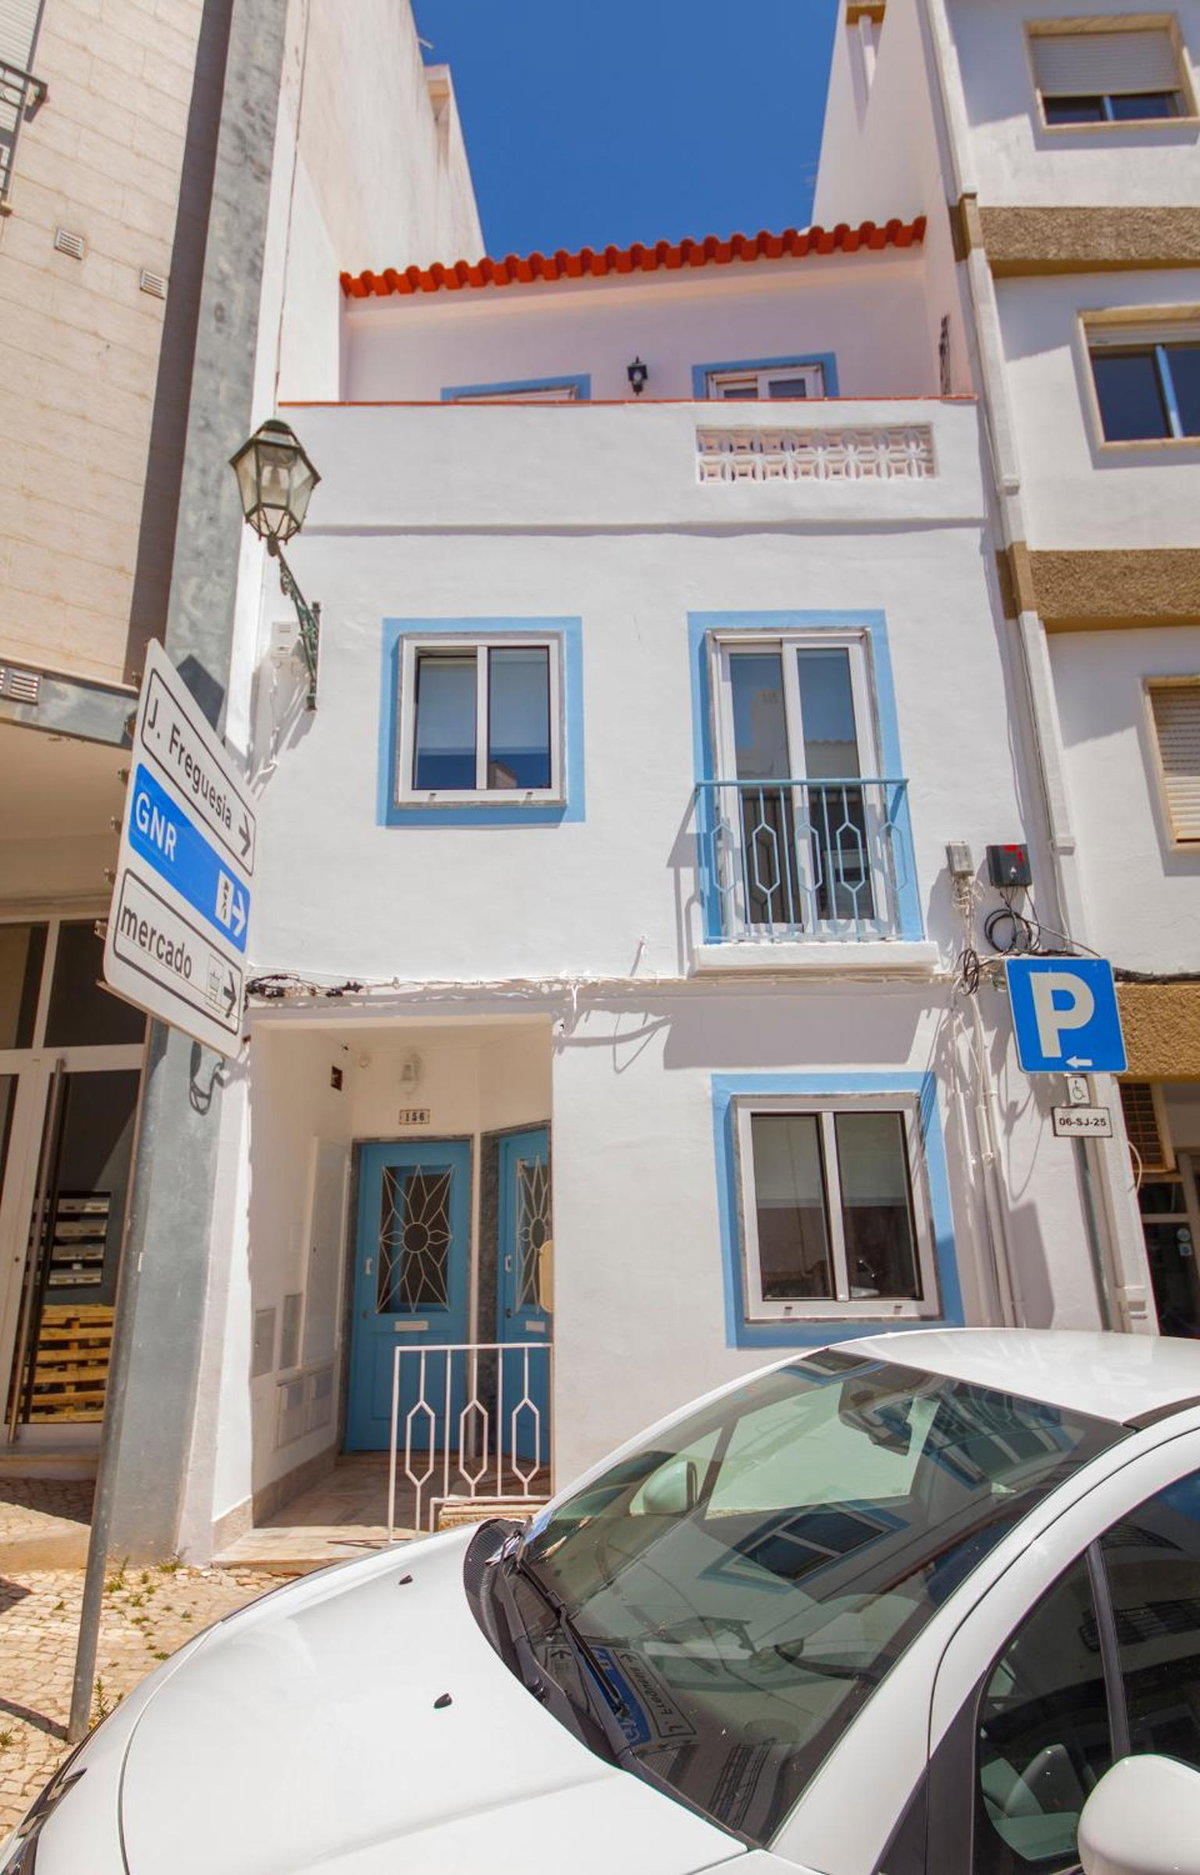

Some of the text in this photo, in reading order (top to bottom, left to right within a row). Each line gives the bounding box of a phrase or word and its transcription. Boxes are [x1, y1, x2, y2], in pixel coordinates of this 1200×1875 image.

[147, 699, 232, 831] J. Freguesia
[136, 793, 178, 861] GNR
[120, 904, 193, 979] mercado
[1029, 971, 1095, 1058] P
[1059, 1117, 1107, 1127] 06-SJ-25
